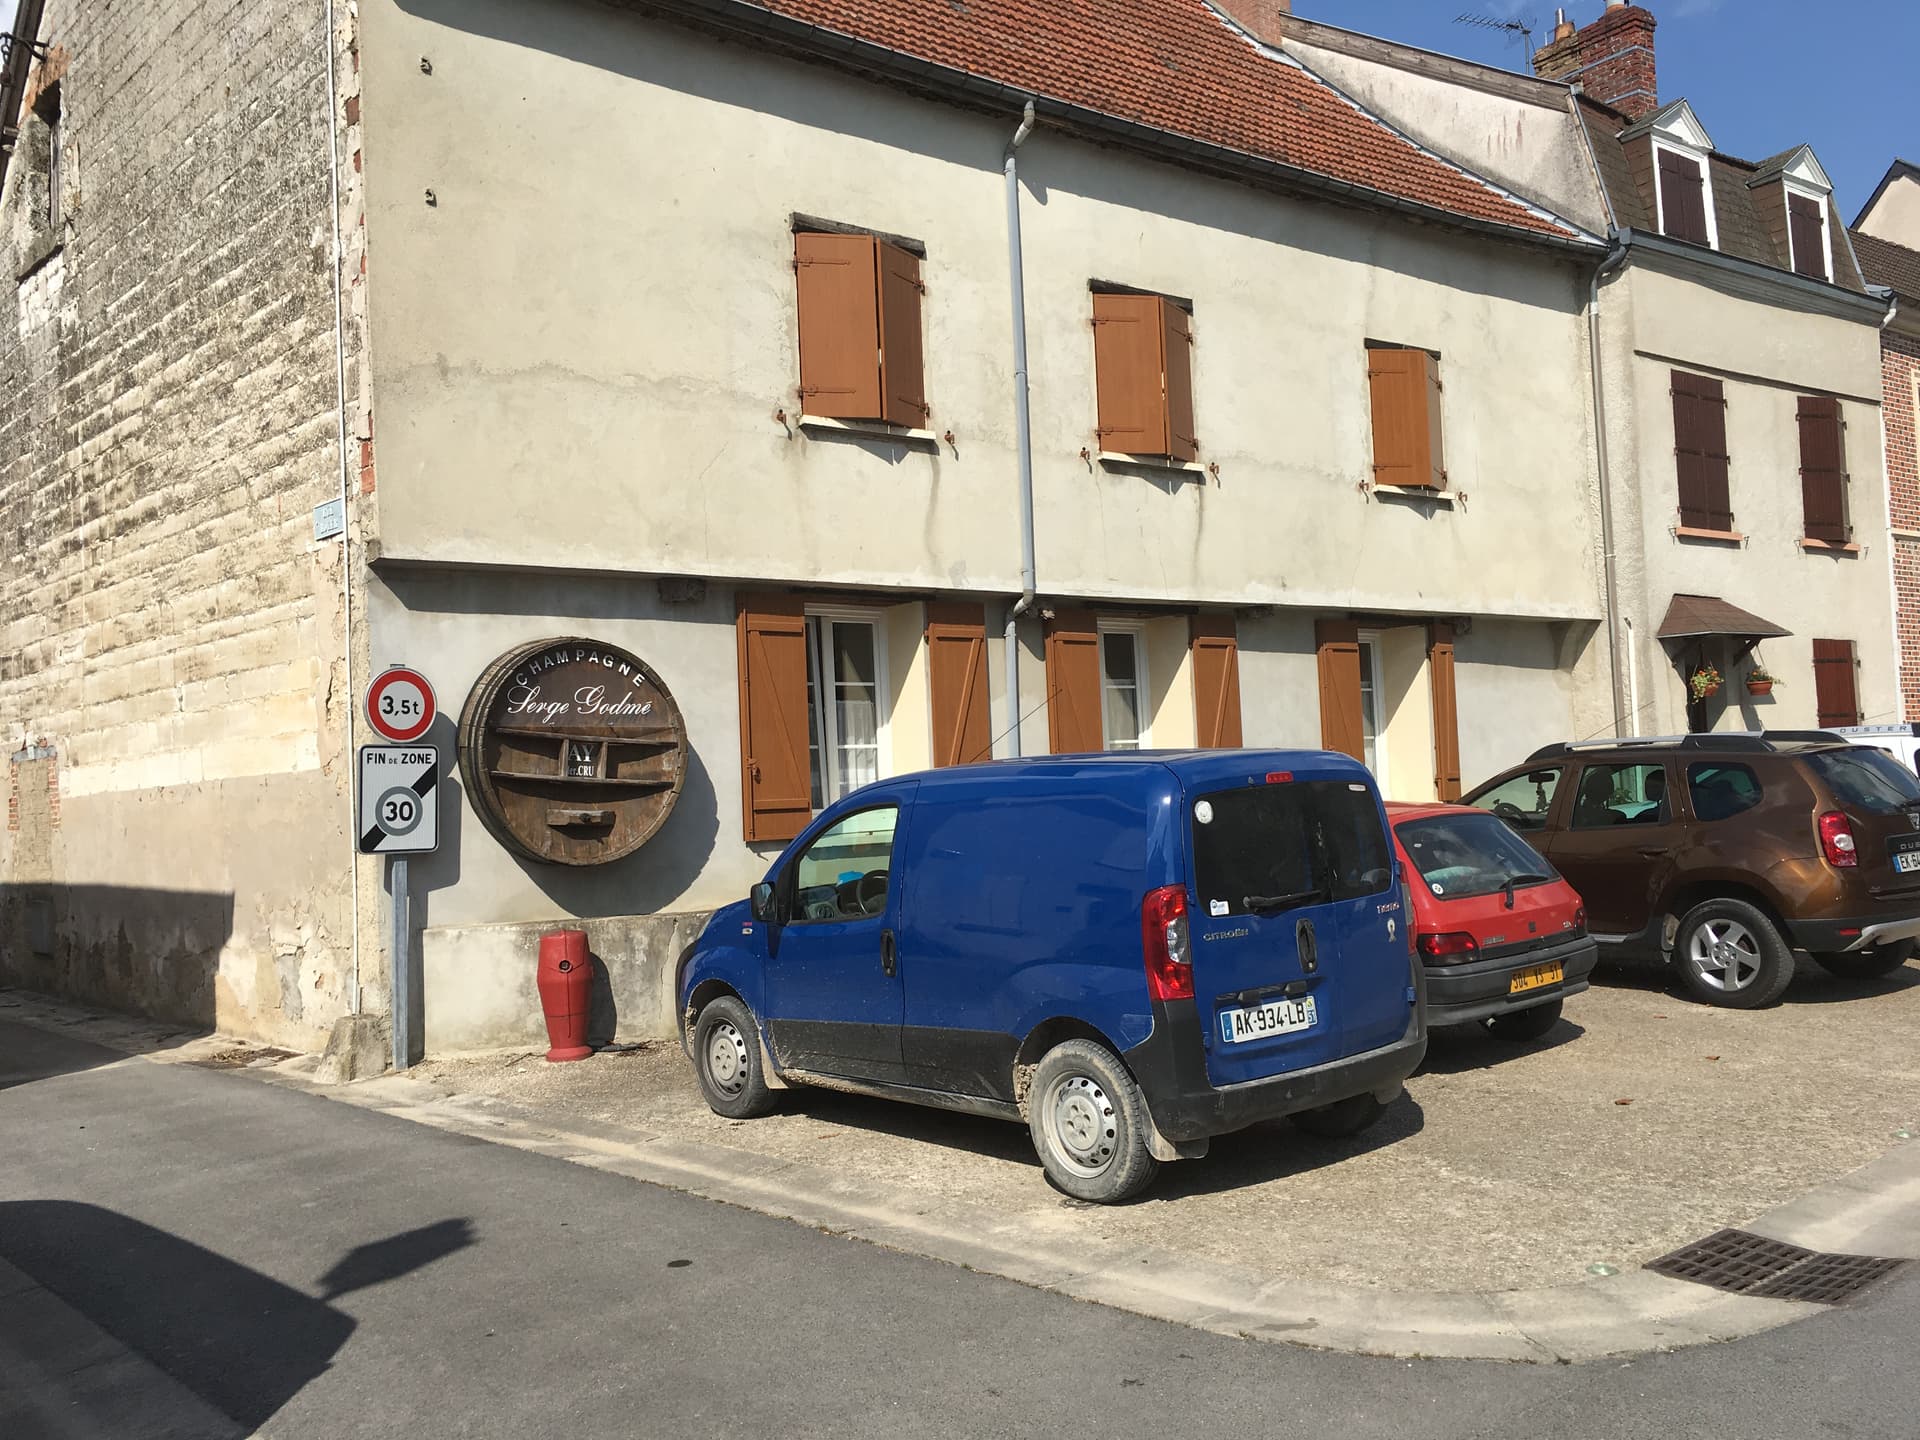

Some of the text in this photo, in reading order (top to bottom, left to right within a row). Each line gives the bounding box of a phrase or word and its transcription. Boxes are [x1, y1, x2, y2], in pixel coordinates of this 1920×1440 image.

[515, 649, 646, 687] CHAMPAGNE
[507, 685, 652, 723] Serge Godmé
[366, 753, 386, 764] FIN
[401, 753, 432, 765] ZONE
[385, 801, 414, 821] 30
